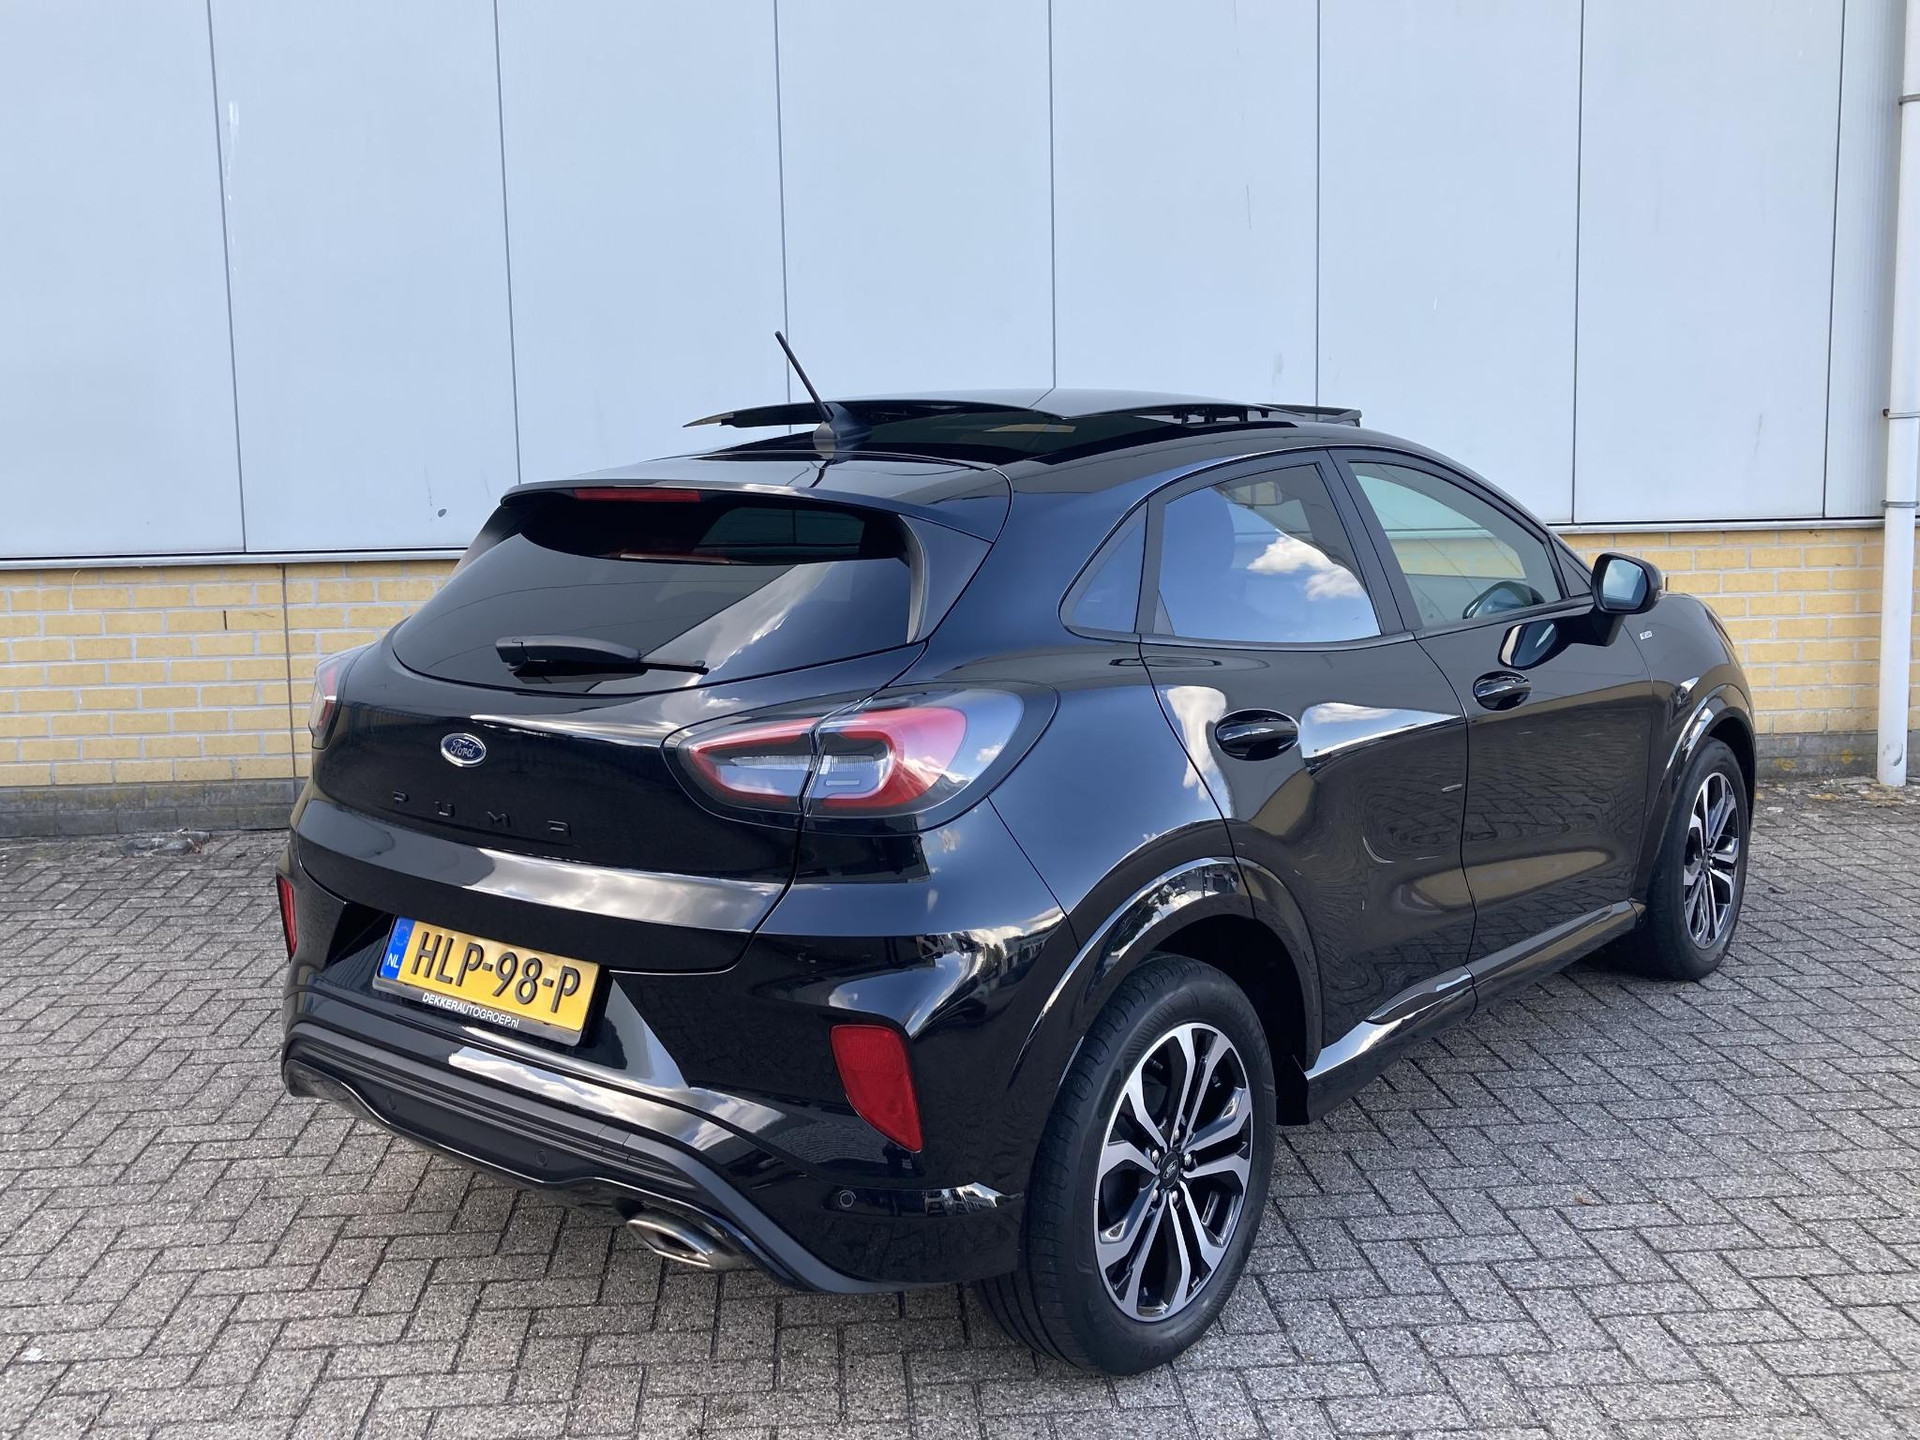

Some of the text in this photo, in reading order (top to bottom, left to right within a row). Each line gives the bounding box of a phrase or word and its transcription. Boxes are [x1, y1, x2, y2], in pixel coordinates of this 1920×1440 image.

[450, 738, 476, 759] Ford
[386, 953, 400, 969] NL
[410, 931, 581, 1014] HLP-98-P
[422, 992, 520, 1028] DEKKERAUTOGROEP.nl
